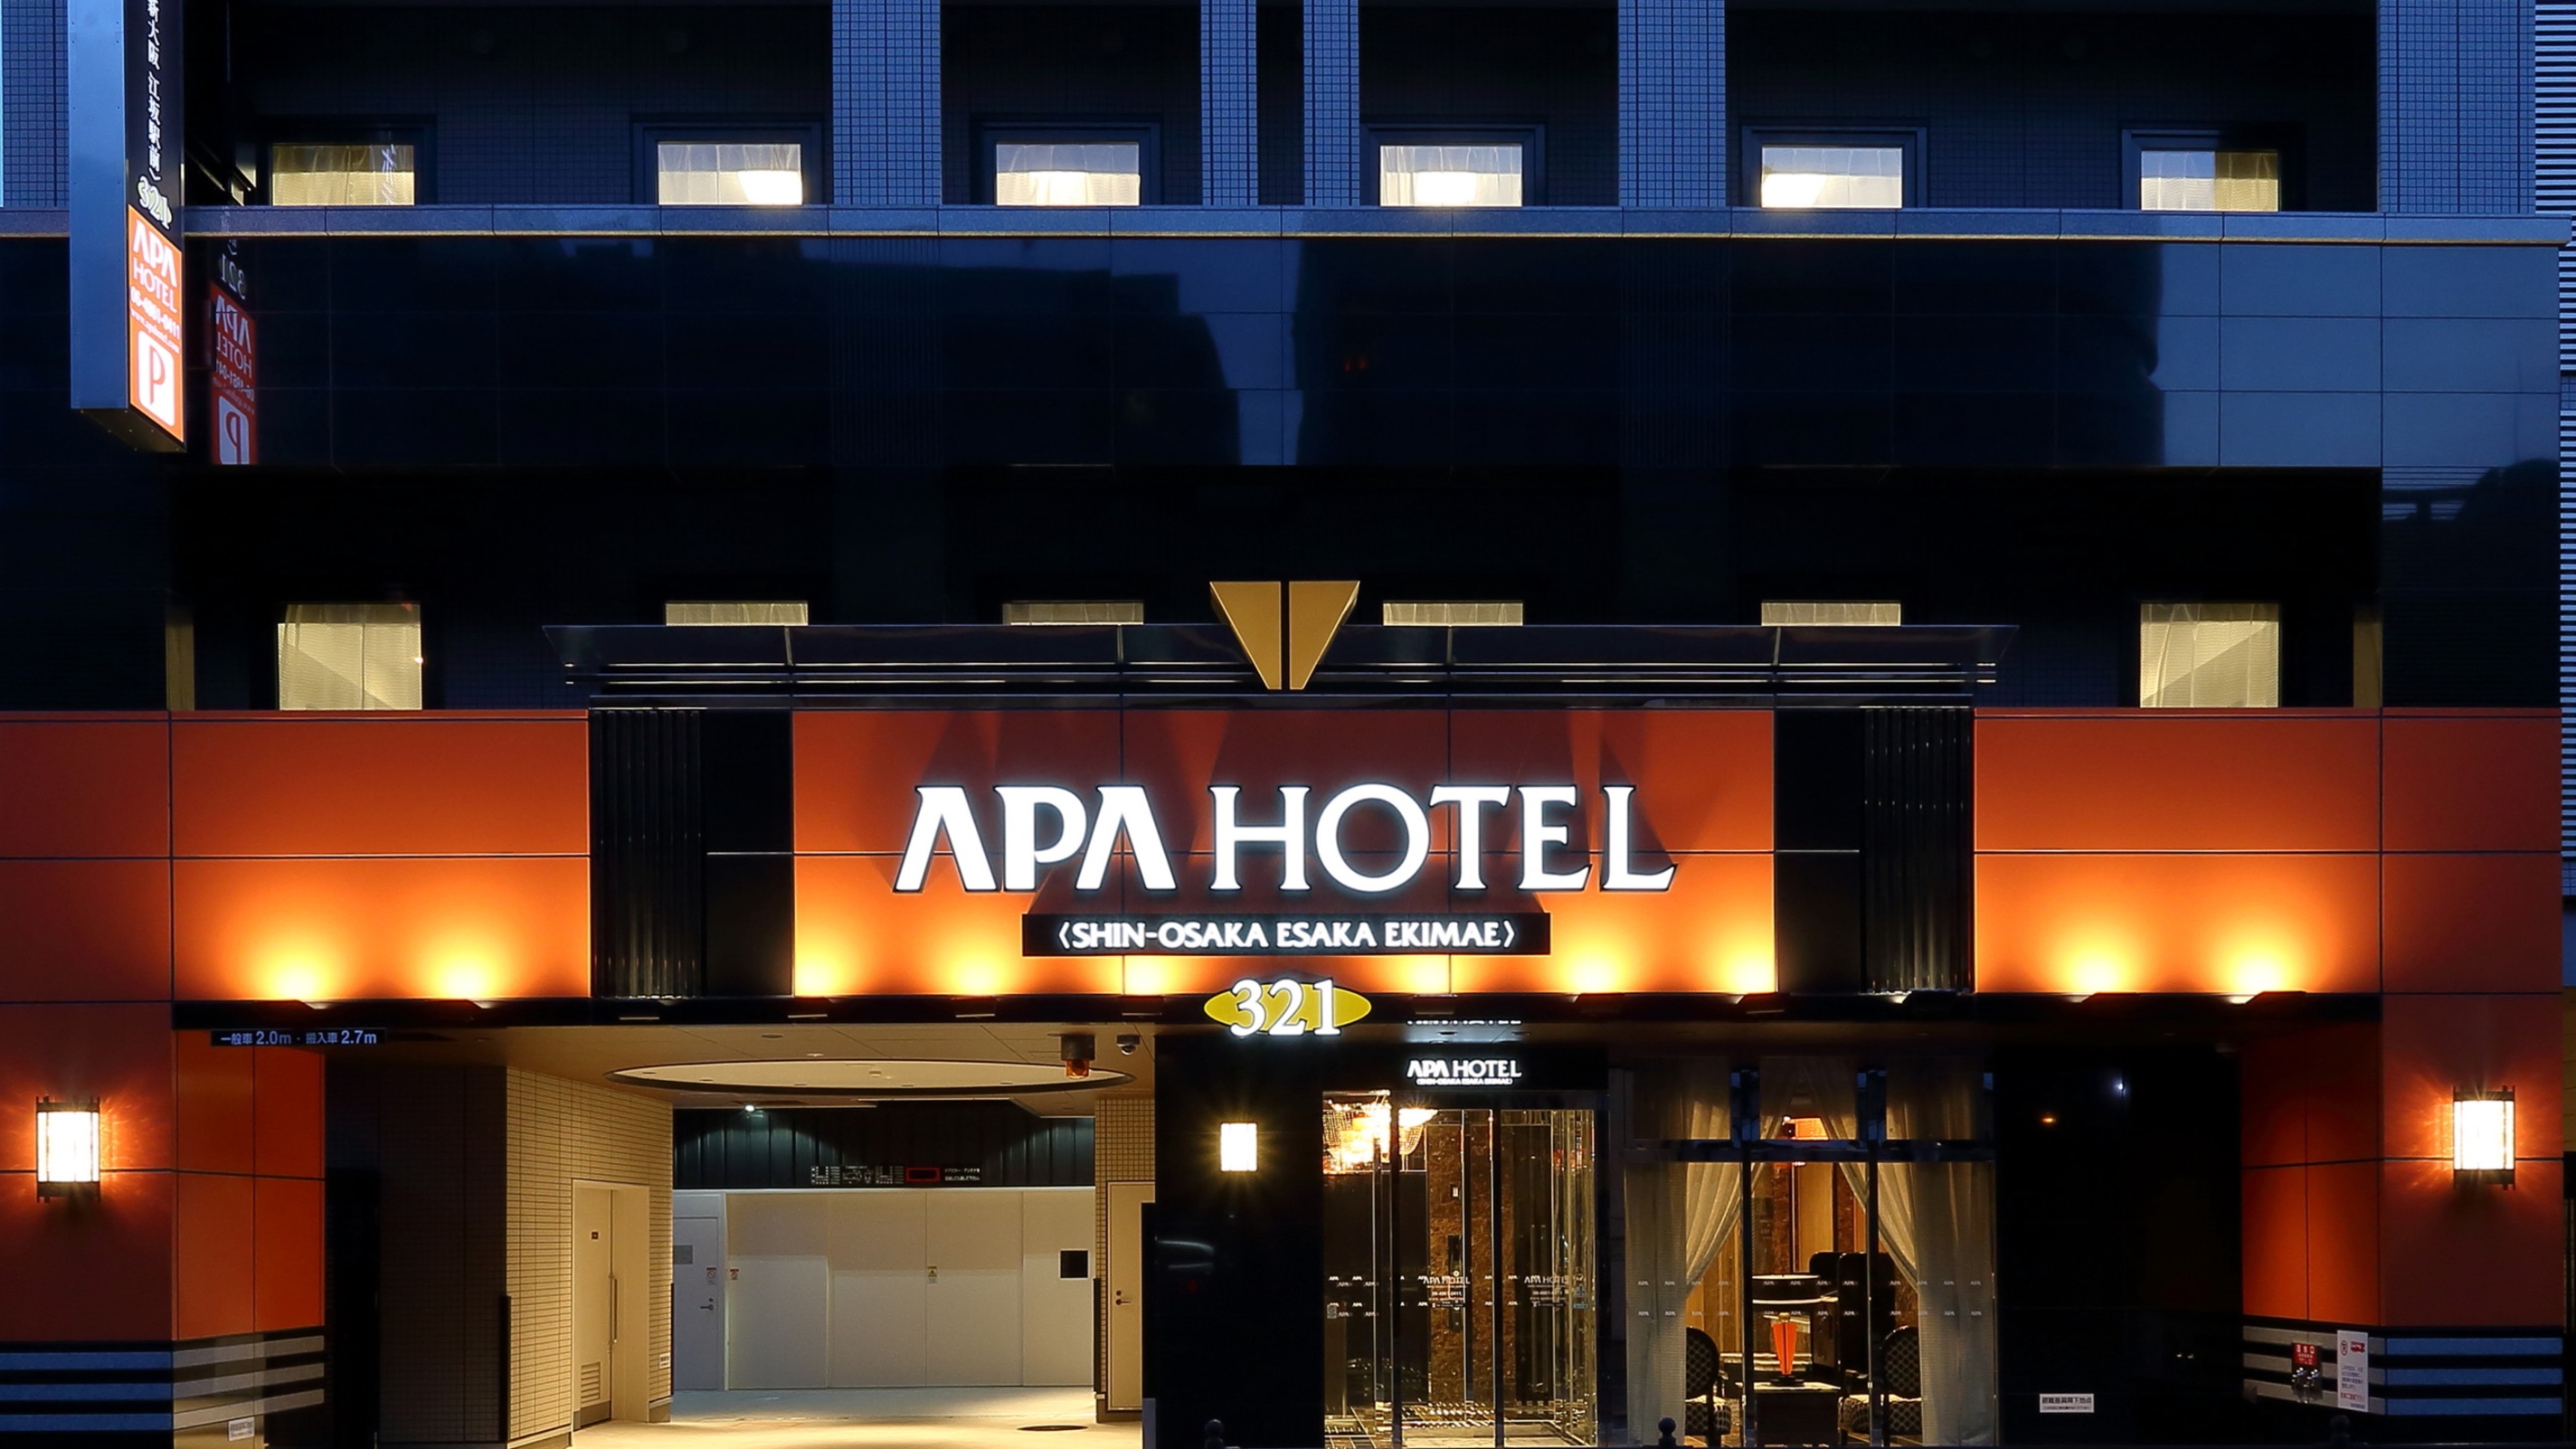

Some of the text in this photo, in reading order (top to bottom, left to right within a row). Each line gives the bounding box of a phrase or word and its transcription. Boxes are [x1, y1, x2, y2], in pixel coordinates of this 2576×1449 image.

[138, 175, 170, 230] 321
[133, 220, 178, 288] APA
[133, 257, 178, 314] HOTEL
[149, 345, 166, 405] P
[894, 783, 1676, 893] APA HOTEL
[1276, 922, 1378, 948] ESAKA
[1229, 978, 1341, 1037] 321
[221, 1032, 253, 1046] 一般車
[256, 1030, 292, 1046] 2.0m
[341, 1029, 377, 1045] 2.7m
[1406, 1059, 1521, 1077] APA HOTEL
